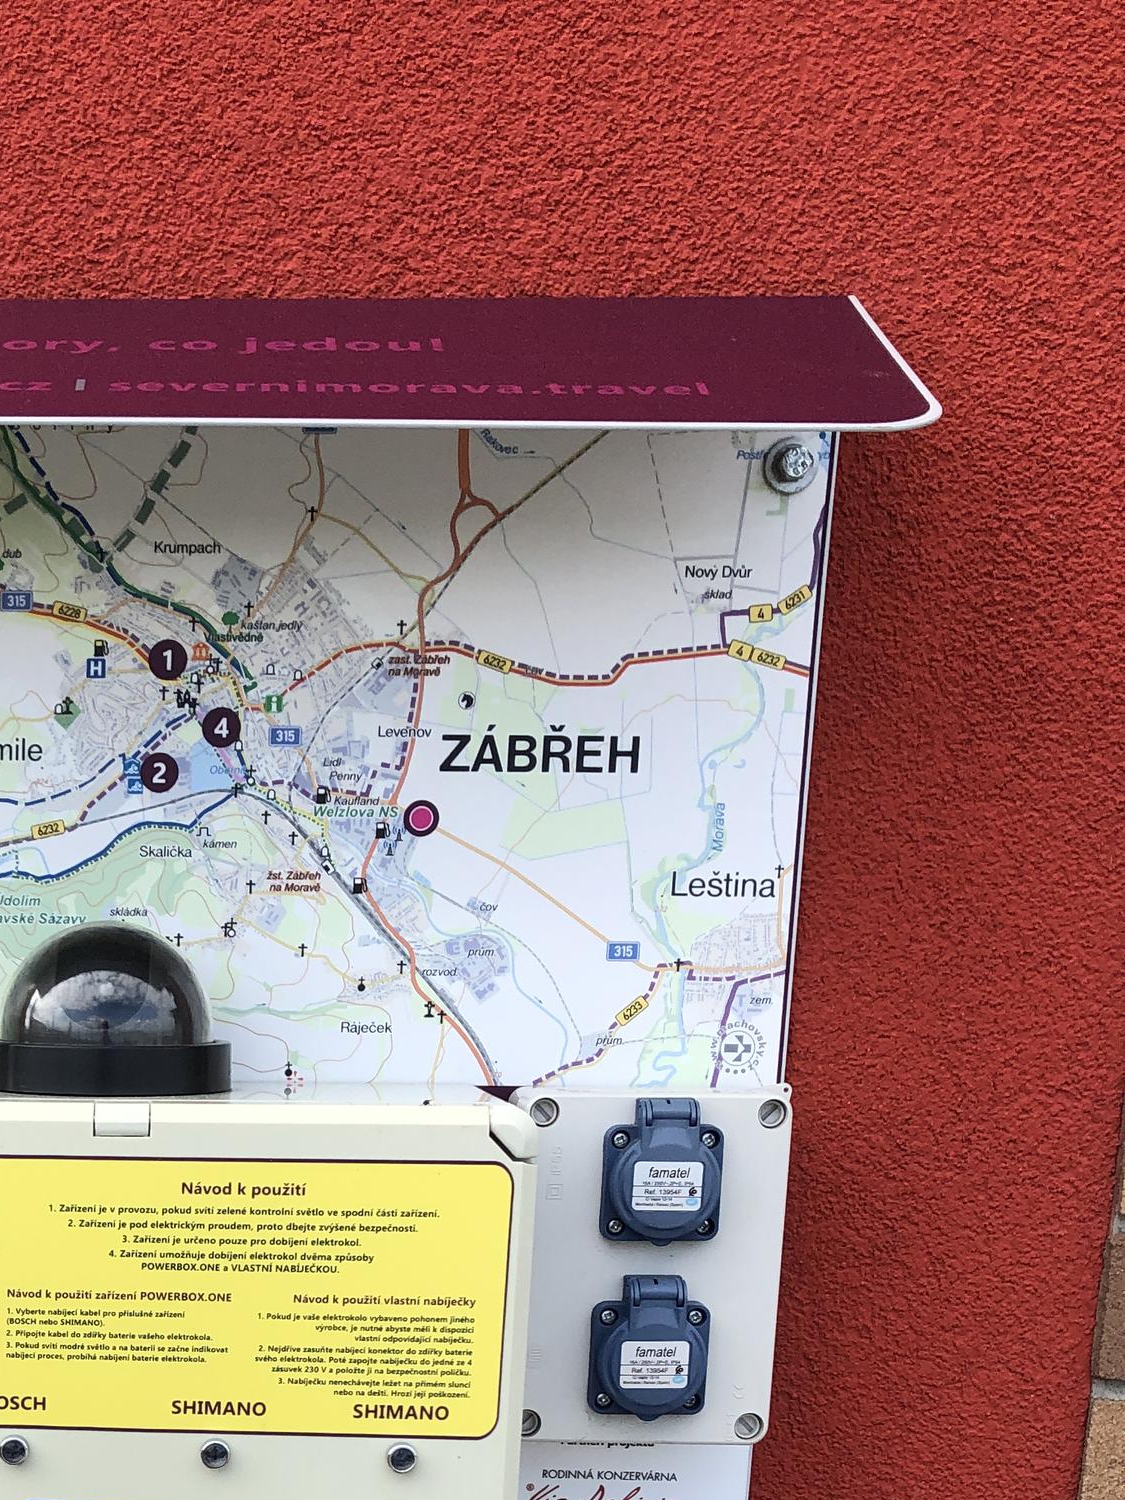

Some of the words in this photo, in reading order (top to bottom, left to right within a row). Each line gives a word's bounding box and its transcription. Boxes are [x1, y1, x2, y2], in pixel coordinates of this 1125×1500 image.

[149, 338, 217, 351] co
[238, 337, 445, 355] jedou!
[108, 379, 711, 395] severnimorava.travel
[154, 542, 221, 555] Krumpach
[684, 566, 718, 579] Nový
[722, 564, 752, 578] Dvůr
[7, 596, 26, 607] 315
[163, 650, 174, 670] 1
[483, 654, 506, 669] 6232
[214, 717, 228, 737] 4
[275, 730, 295, 742] 315
[439, 724, 640, 774] ZÁBŘEH
[152, 762, 166, 783] 2
[329, 771, 362, 783] Penny
[314, 806, 376, 819] Welzlova
[381, 807, 398, 818] NS
[37, 823, 59, 836] 6232
[139, 845, 192, 859] Skalička
[288, 871, 321, 881] Zábřeh
[270, 883, 281, 892] na
[284, 883, 320, 892] Moravě
[671, 871, 776, 898] Leština
[614, 946, 633, 957] 315
[340, 1021, 392, 1034] Ráječek
[649, 1166, 691, 1179] famatel
[181, 1182, 232, 1195] Návod
[238, 1183, 246, 1195] k
[251, 1183, 306, 1198] použití
[7, 1289, 42, 1299] Návod
[46, 1290, 51, 1299] k
[55, 1290, 92, 1301] použití
[95, 1290, 137, 1300] zařízení
[140, 1292, 232, 1302] POWERBOX.ONE
[635, 1346, 677, 1359] famatel
[171, 1400, 266, 1416] SHIMANO
[353, 1404, 449, 1420] SHIMANO
[542, 1468, 593, 1480] RODINNÁ
[597, 1469, 677, 1482] KONZERVÁRNA
